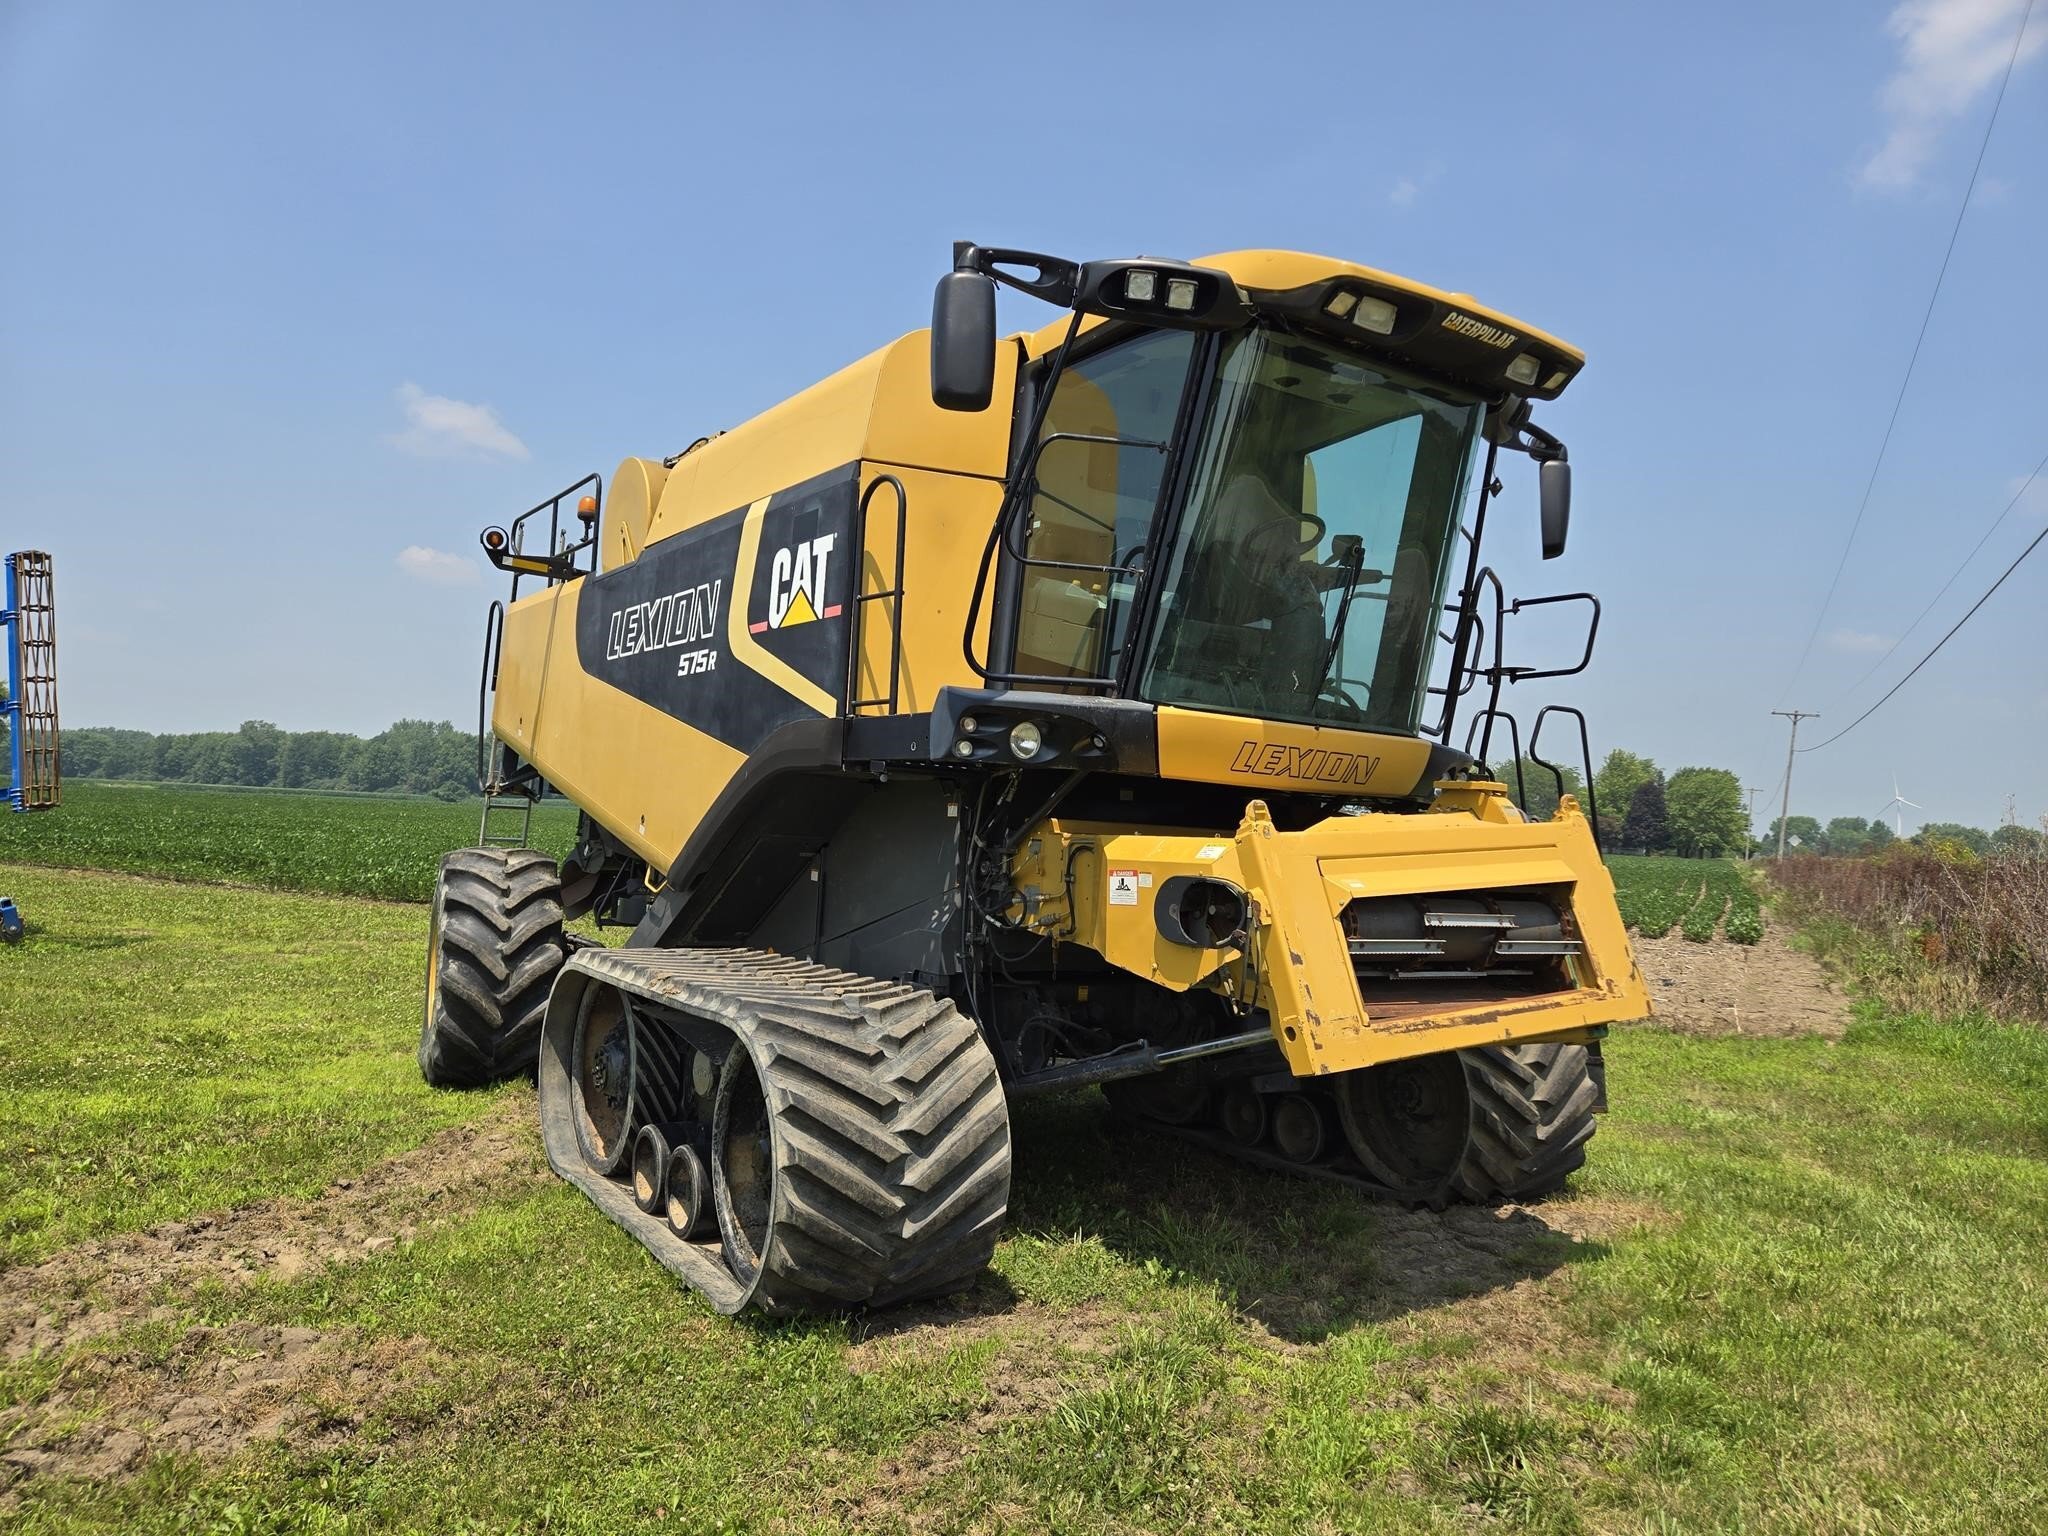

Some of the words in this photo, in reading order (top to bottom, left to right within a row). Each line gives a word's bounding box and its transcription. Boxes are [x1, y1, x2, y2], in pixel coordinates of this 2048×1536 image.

[1441, 311, 1515, 349] CATERPILLAR
[768, 533, 834, 629] CAT
[607, 579, 721, 660] LEXION
[1230, 741, 1380, 785] LEXION
